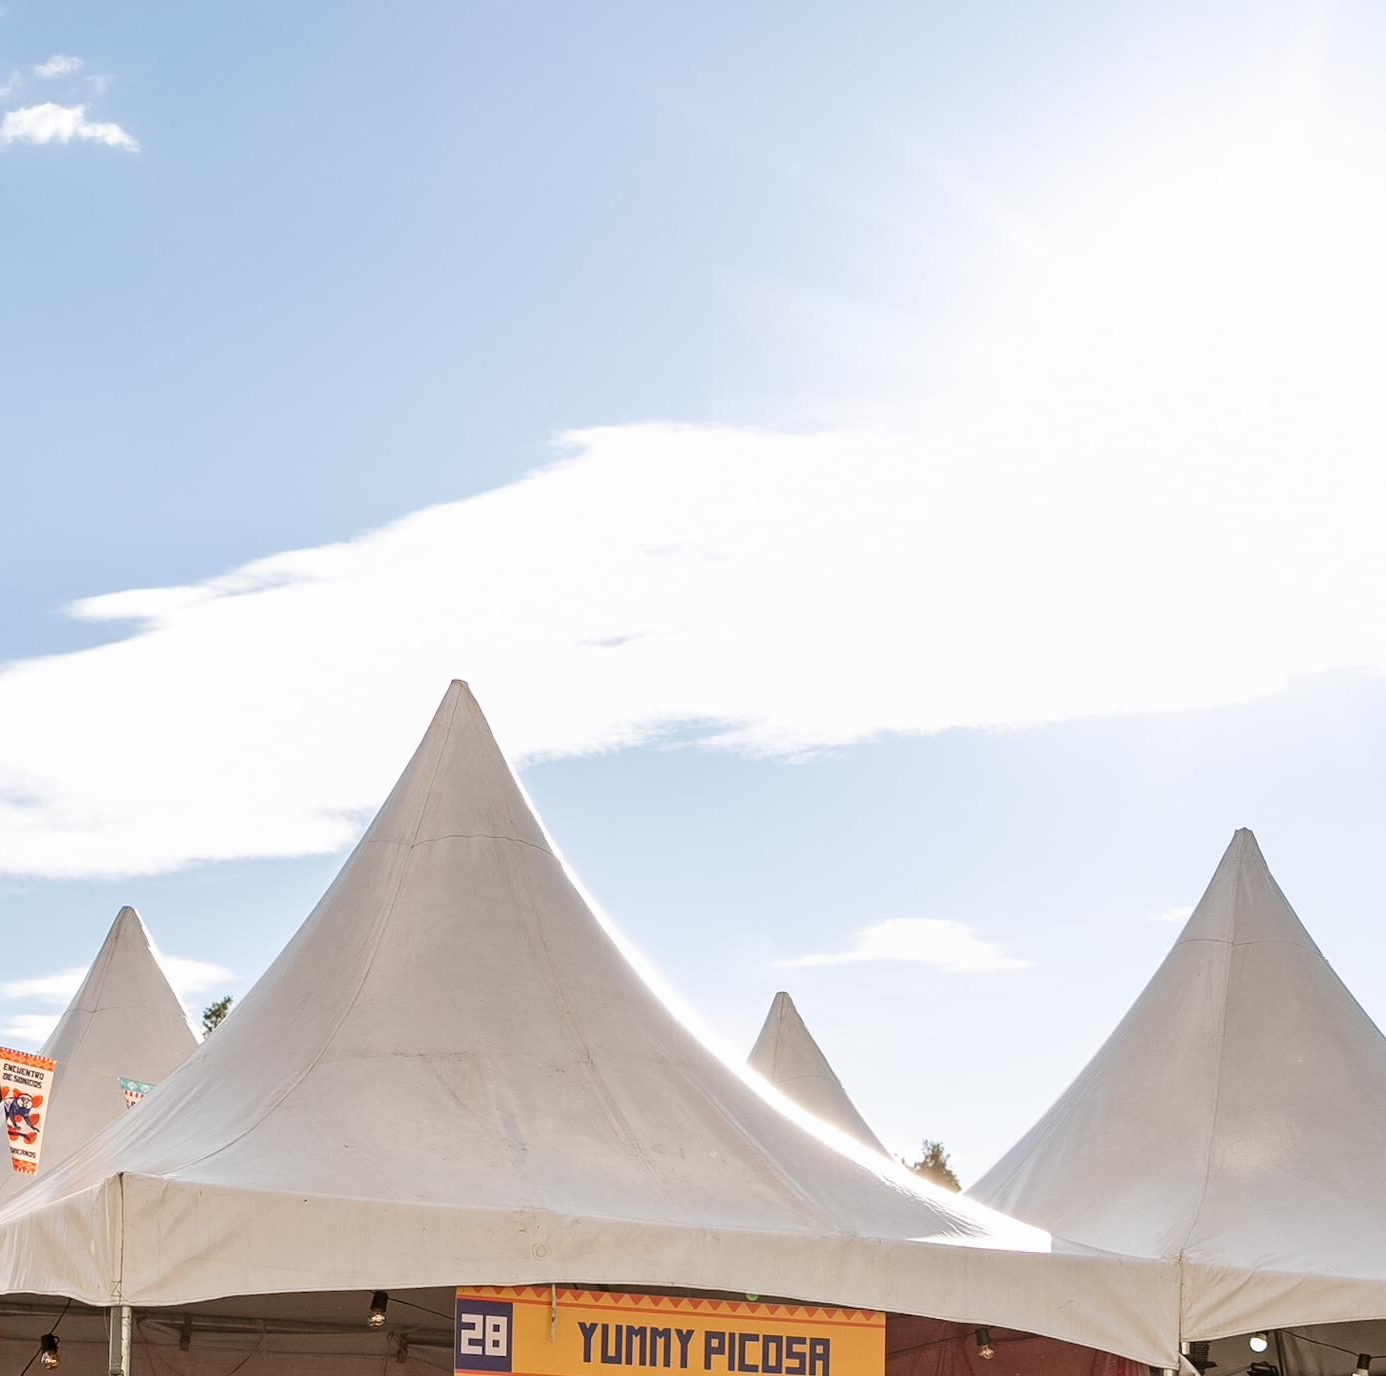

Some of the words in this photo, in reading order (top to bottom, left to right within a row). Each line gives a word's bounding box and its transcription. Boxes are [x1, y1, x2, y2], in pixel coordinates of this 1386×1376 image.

[2, 1072, 13, 1082] DE
[3, 1062, 45, 1081] ENCUENTRO
[460, 1313, 509, 1358] 28
[577, 1321, 694, 1370] YUMMY
[703, 1330, 831, 1376] PICOSA
